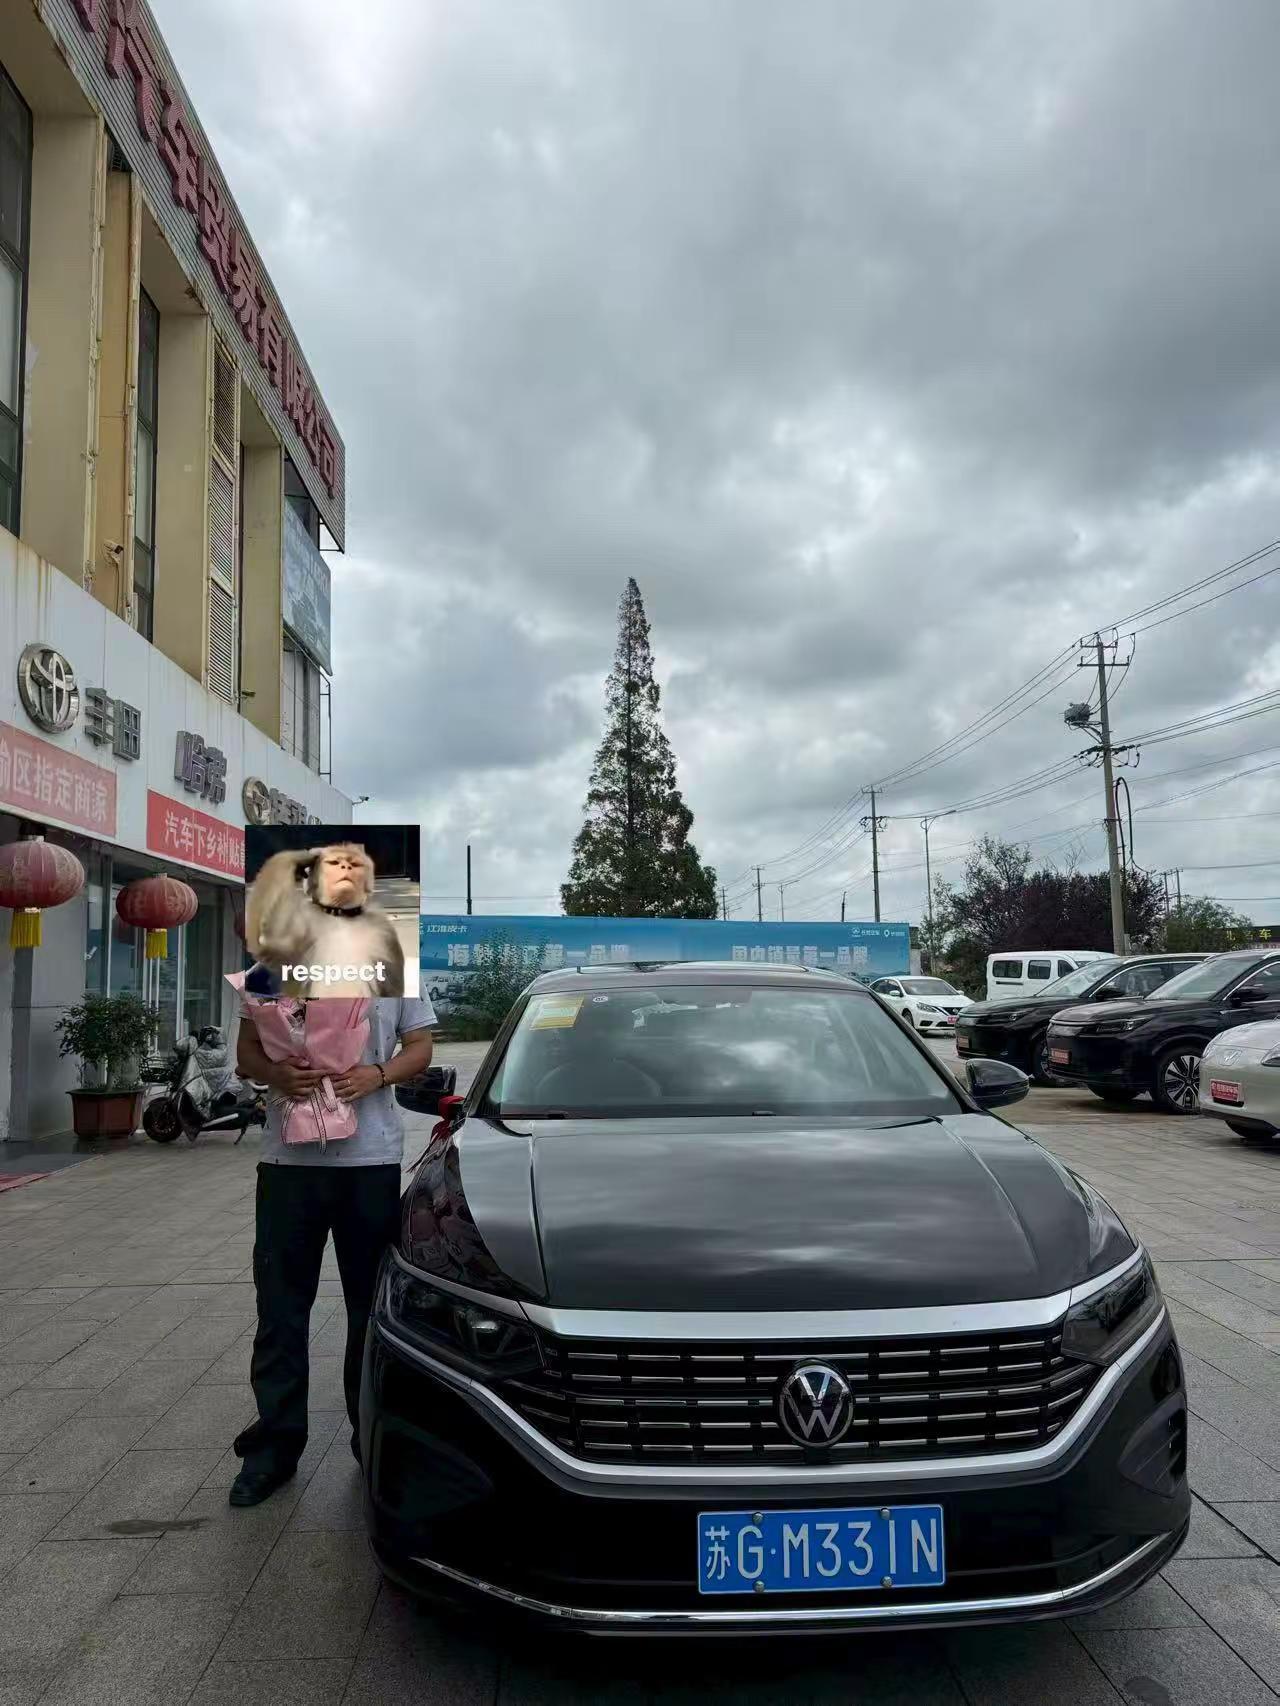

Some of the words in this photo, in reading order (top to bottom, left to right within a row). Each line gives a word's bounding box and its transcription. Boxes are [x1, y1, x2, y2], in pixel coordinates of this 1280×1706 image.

[74, 0, 339, 499] 汽车贸易有限公司
[85, 687, 141, 761] 丰田
[704, 1518, 938, 1581] 苏G·M331N
